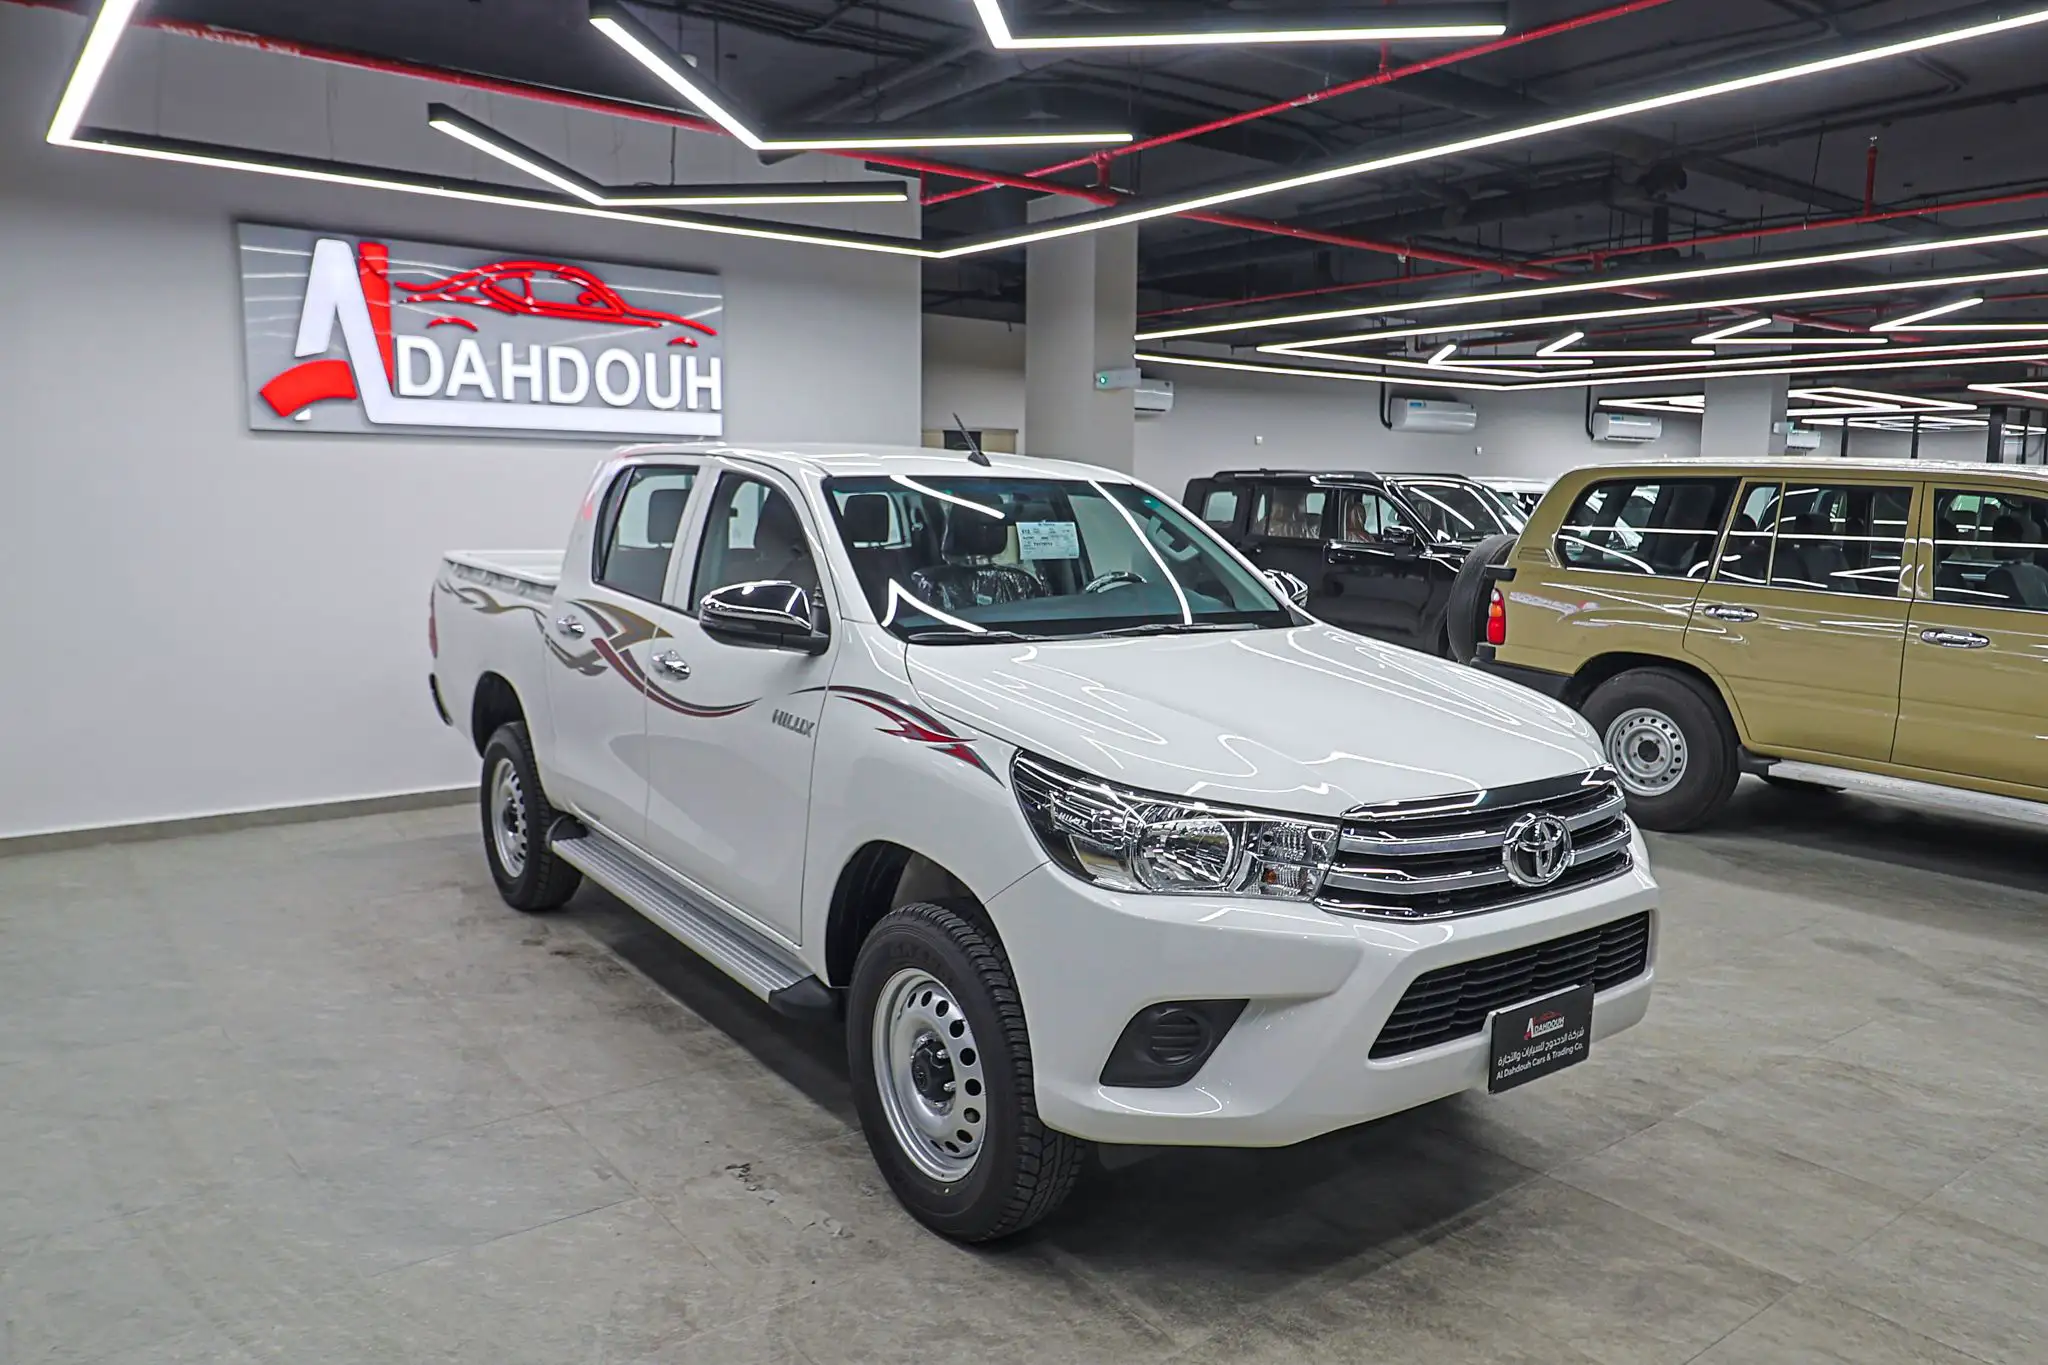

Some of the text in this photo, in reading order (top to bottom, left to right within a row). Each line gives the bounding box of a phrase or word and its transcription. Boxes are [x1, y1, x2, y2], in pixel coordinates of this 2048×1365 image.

[772, 709, 816, 738] HILUX
[1504, 1061, 1532, 1076] Dahdouh
[1532, 1056, 1546, 1067] Cars
[1552, 1045, 1574, 1059] Trading
[1574, 1042, 1584, 1050] Co.
